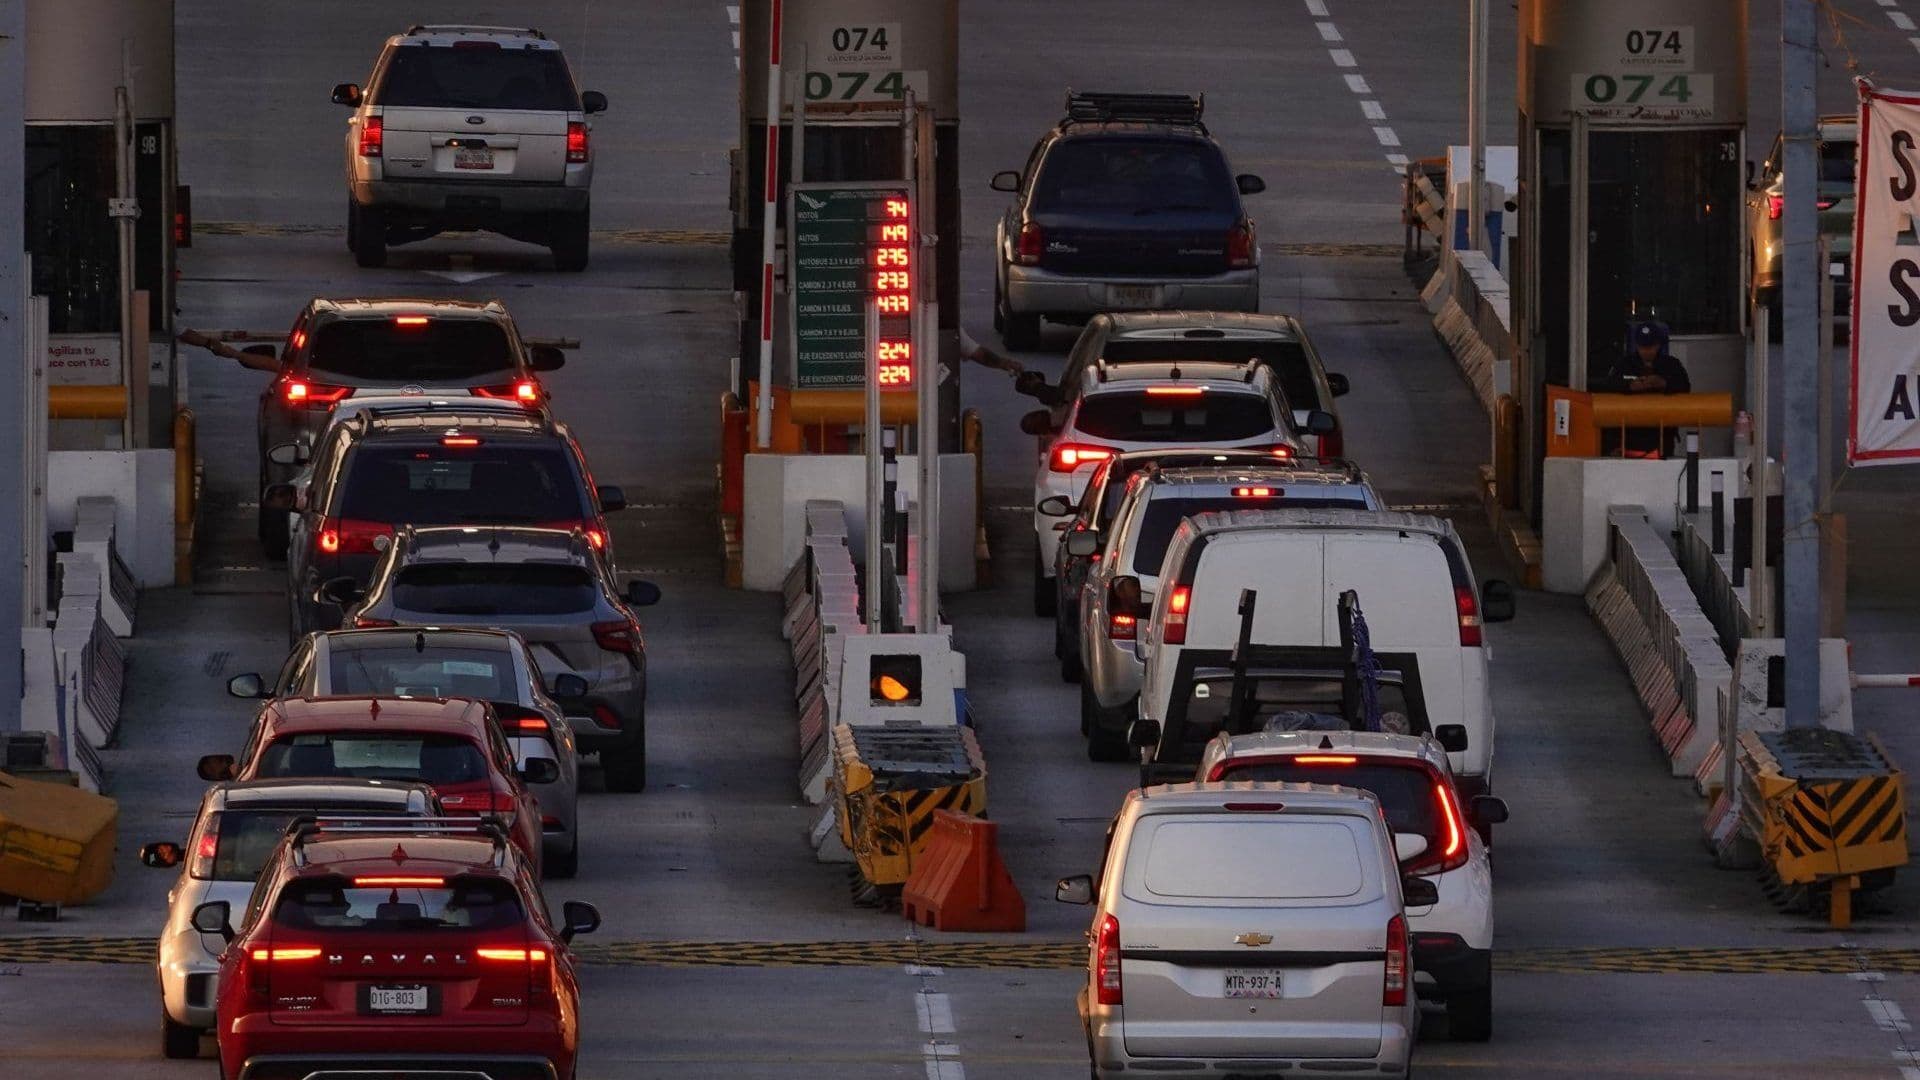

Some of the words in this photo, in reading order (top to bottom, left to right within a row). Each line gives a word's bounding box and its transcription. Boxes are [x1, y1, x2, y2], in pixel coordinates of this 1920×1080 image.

[832, 28, 888, 51] 074
[1626, 30, 1682, 54] 074
[805, 72, 905, 100] 074
[1585, 75, 1693, 103] 074
[142, 136, 156, 154] 9B
[887, 201, 907, 217] 74
[882, 224, 907, 241] 149
[877, 248, 908, 266] 275
[878, 295, 909, 312] 477
[879, 365, 911, 383] 229
[329, 954, 466, 964] HAVAL
[1225, 976, 1281, 989] MTR-937-A
